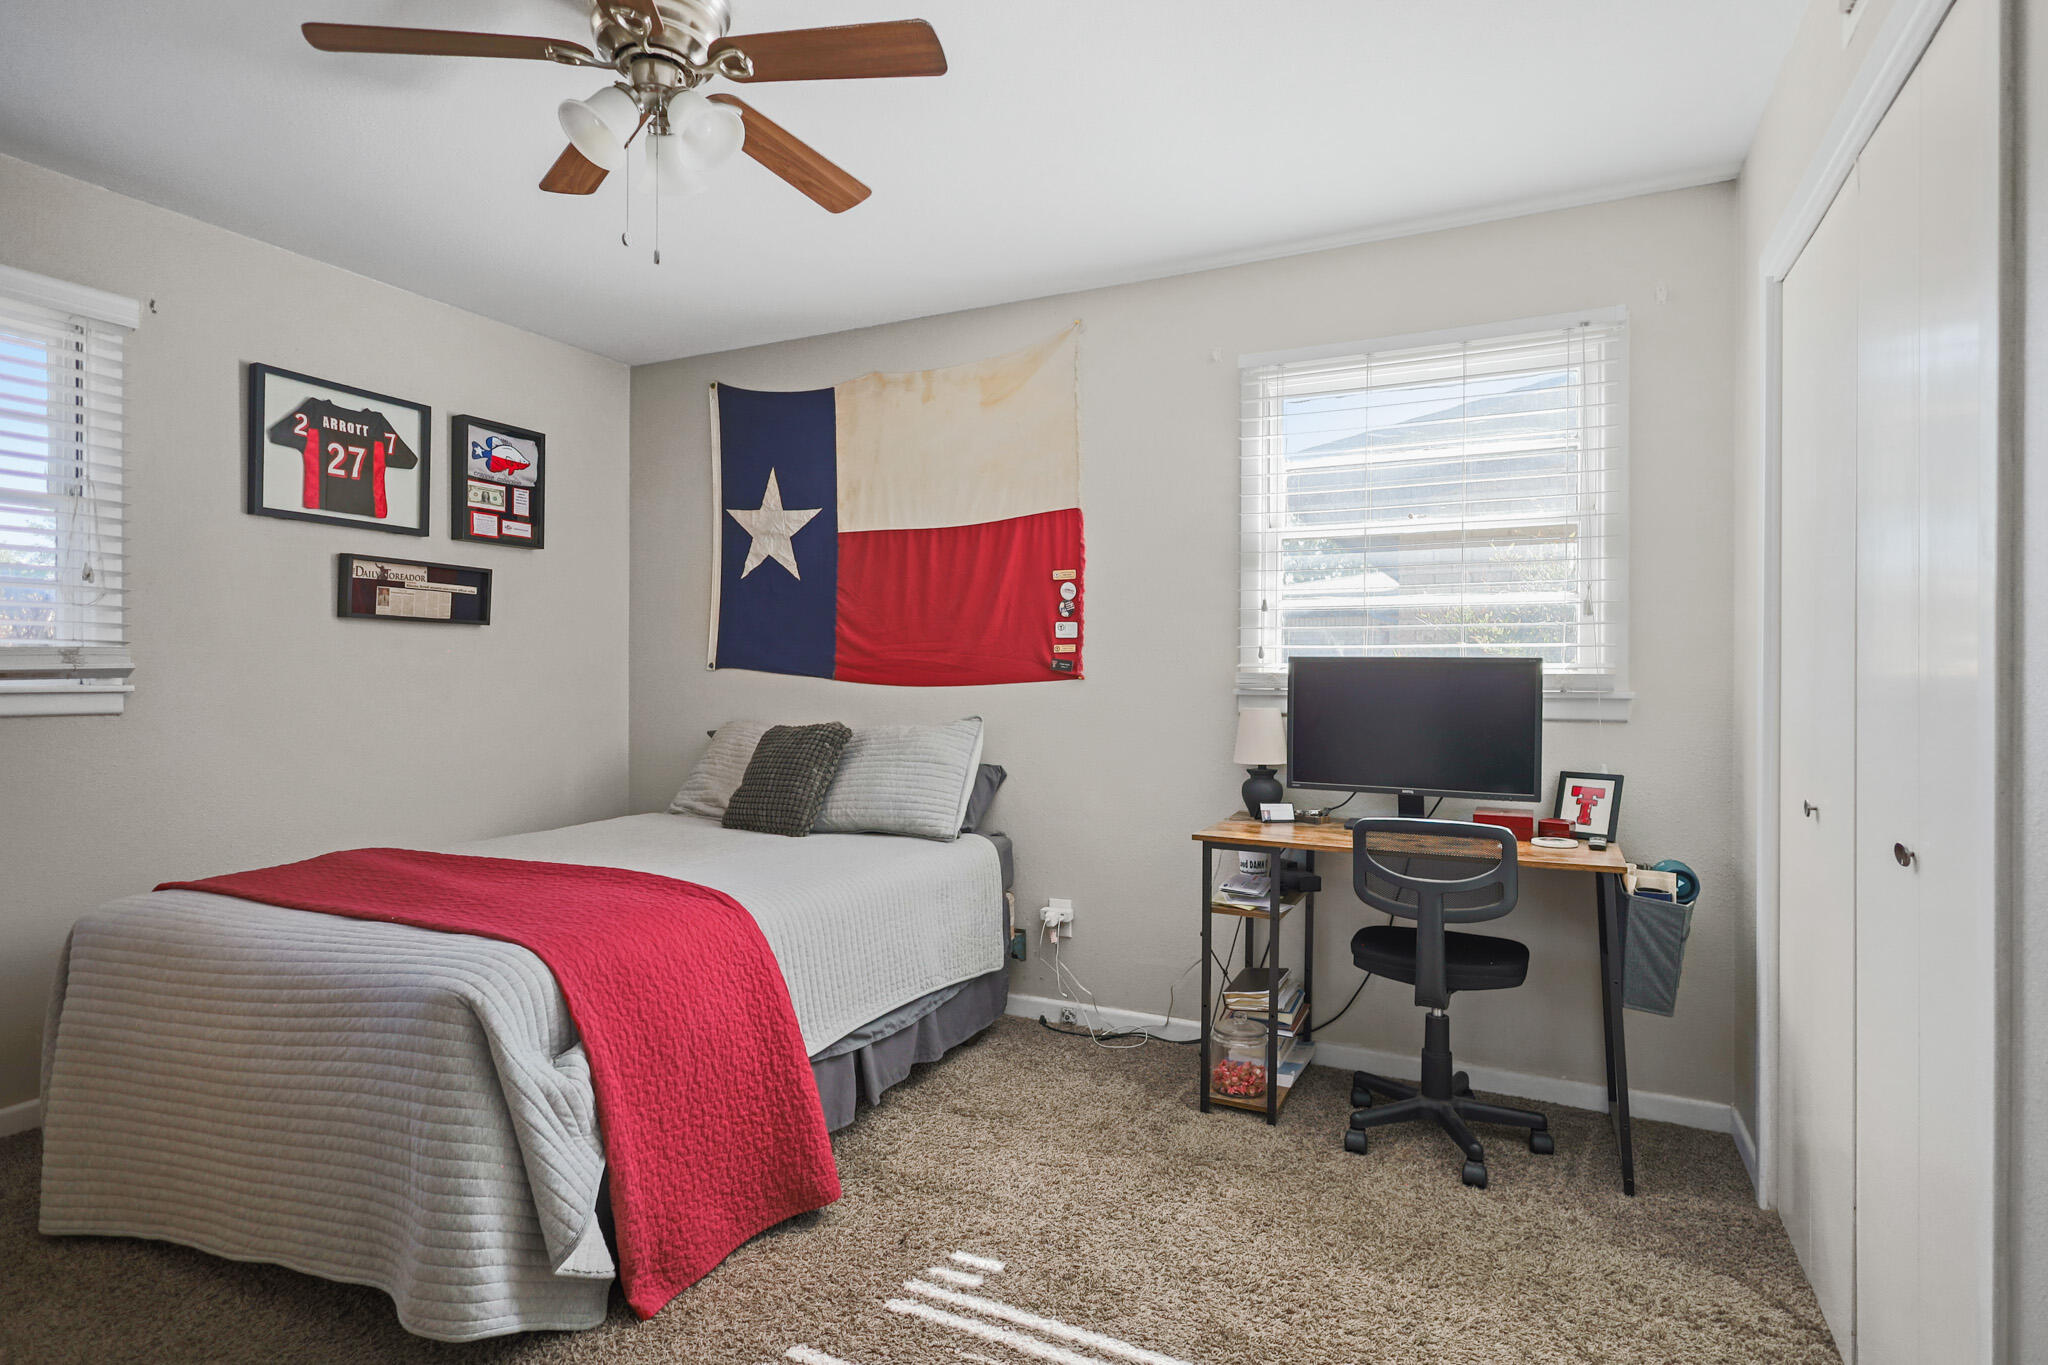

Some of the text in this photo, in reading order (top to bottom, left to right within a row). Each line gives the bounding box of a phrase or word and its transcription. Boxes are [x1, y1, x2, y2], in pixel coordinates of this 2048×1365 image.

[293, 413, 309, 437] 2
[384, 432, 397, 455] 7
[327, 442, 368, 480] 27
